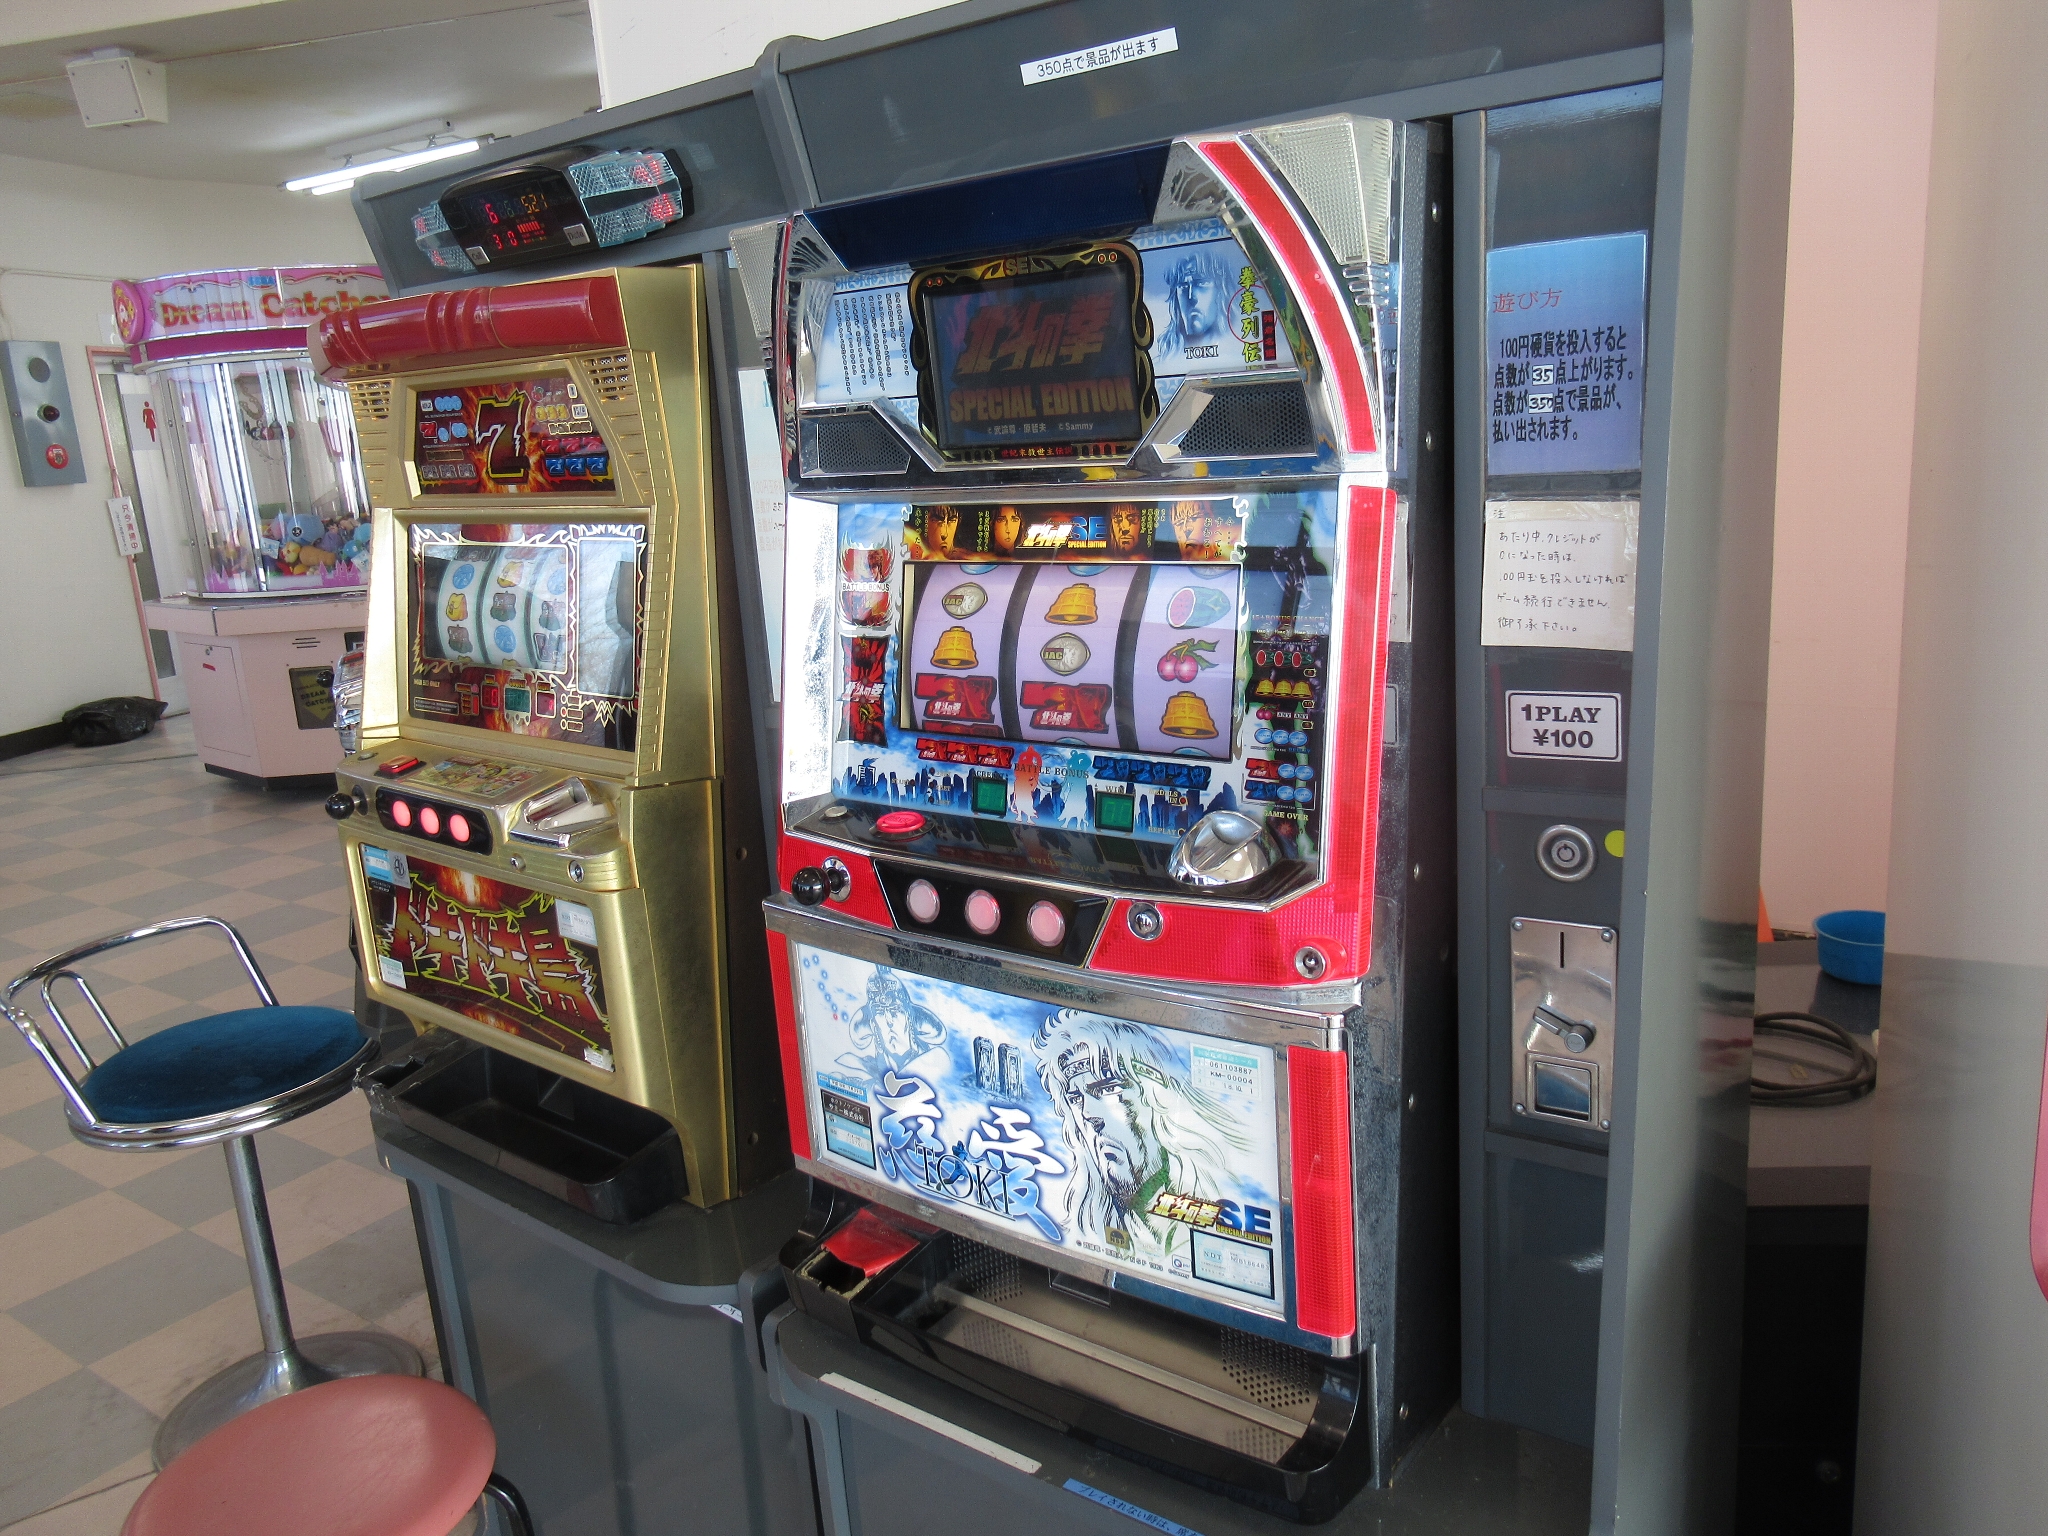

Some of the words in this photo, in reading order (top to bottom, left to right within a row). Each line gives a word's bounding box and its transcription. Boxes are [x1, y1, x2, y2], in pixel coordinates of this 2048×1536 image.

[1036, 36, 1159, 78] 350点で景品が出ます
[567, 229, 585, 241] Data
[1492, 288, 1563, 313] 遊び方
[161, 302, 254, 328] Dream
[1184, 345, 1219, 359] TOKI
[1499, 325, 1627, 359] 100円硬貨を投入すると
[950, 387, 1036, 423] SPECIAL
[1042, 376, 1136, 417] EDITION
[1492, 415, 1578, 443] 払い出されます。
[1043, 651, 1063, 660] JAC
[1533, 728, 1594, 748] ¥100
[1014, 763, 1052, 775] BATTLE
[1054, 767, 1090, 779] BONUS
[1263, 809, 1286, 819] GAME
[1286, 812, 1309, 822] OVER
[1148, 825, 1177, 835] REPLAY
[914, 1139, 1016, 1217] TOKI
[1216, 1198, 1272, 1235] SE
[1216, 1225, 1243, 1238] SPECIAL
[1244, 1229, 1273, 1245] EDITION
